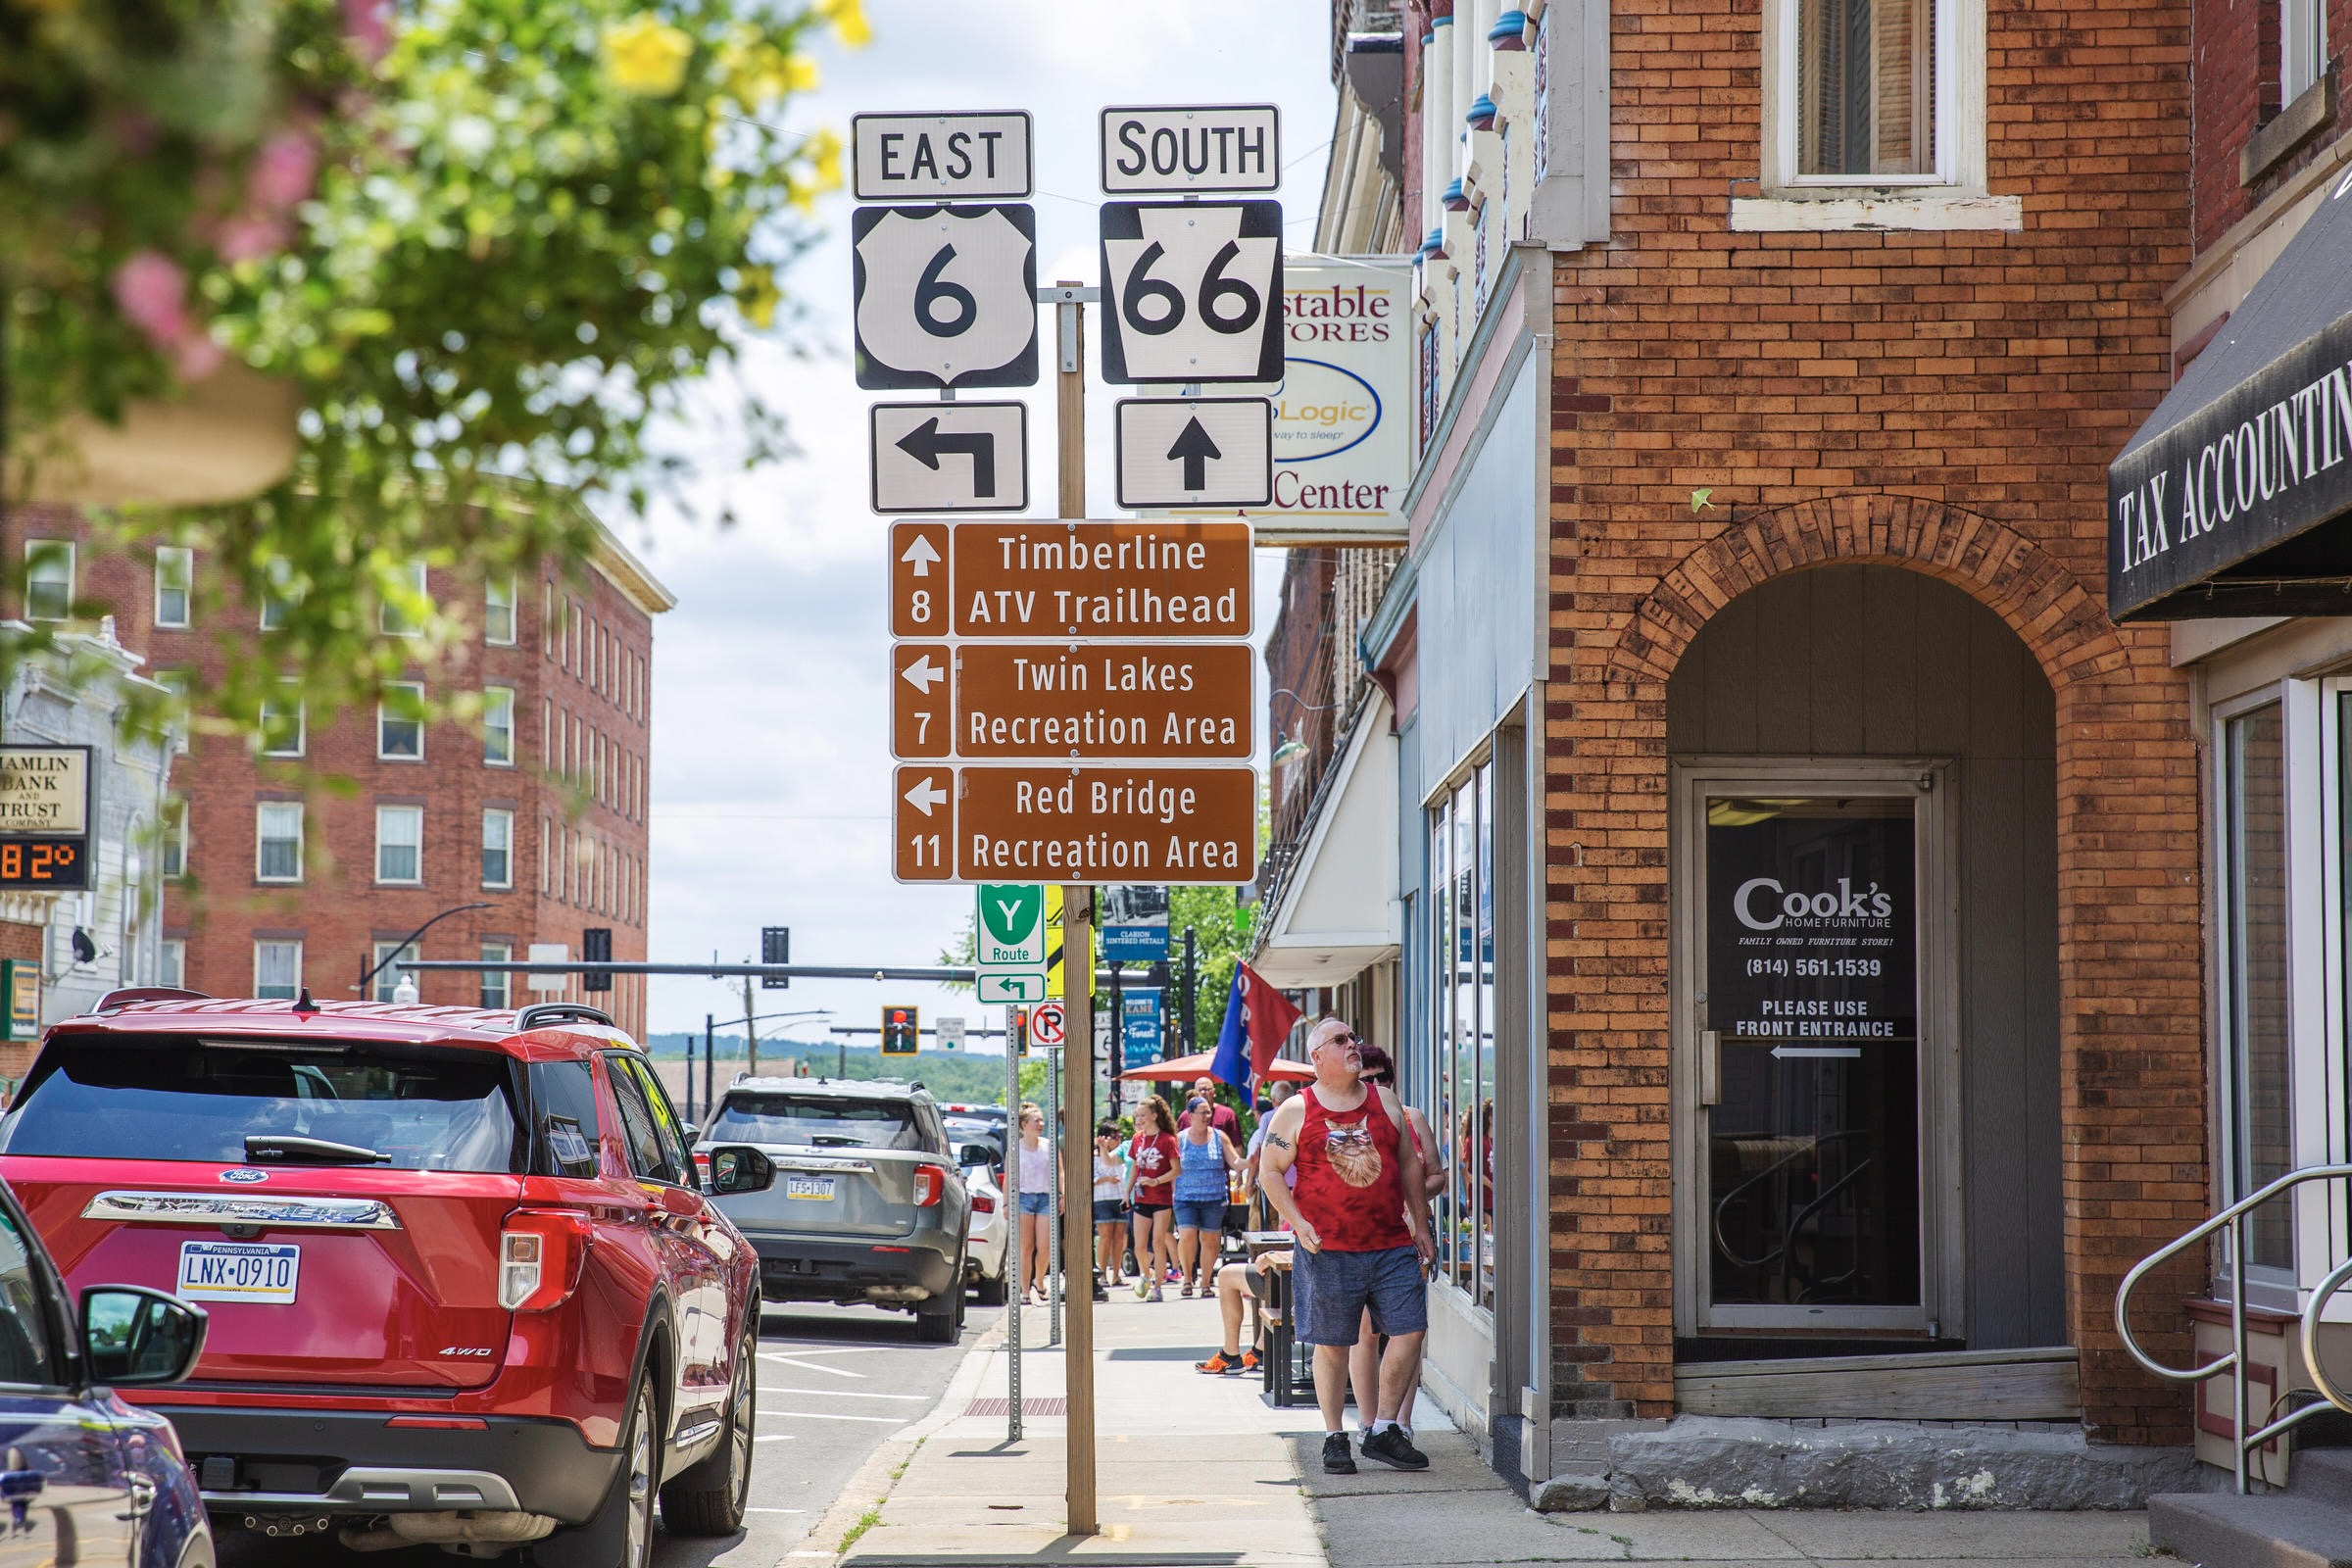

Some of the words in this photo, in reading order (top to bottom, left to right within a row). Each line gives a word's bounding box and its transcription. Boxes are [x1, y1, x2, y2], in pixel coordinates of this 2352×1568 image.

[880, 131, 1003, 180] EAST
[1116, 120, 1265, 176] SOUTH
[914, 242, 977, 337] 6
[1123, 240, 1261, 335] 66
[1283, 284, 1390, 318] stable
[1284, 322, 1390, 342] ORES
[1273, 401, 1367, 426] Logic
[1297, 431, 1307, 440] to
[1274, 470, 1390, 510] Center
[2118, 470, 2170, 573] TAX
[998, 534, 1206, 570] Timberline
[910, 590, 932, 623] 8
[968, 591, 1036, 623] ATV
[1054, 587, 1236, 623] Trailhead
[1013, 656, 1087, 692] Twin
[1104, 657, 1194, 692] Lakes
[913, 712, 932, 745] 7
[970, 709, 1147, 745] Recreation
[1162, 711, 1237, 745] Area
[1, 775, 57, 791] BANK
[0, 803, 62, 818] TRUST
[1016, 780, 1074, 814] Red
[1091, 779, 1197, 824] Bridge
[910, 834, 941, 867] 11
[973, 832, 1150, 867] Recreation
[1165, 835, 1239, 867] Area
[997, 900, 1022, 931] Y
[1733, 877, 1892, 931] Cook's
[1786, 917, 1821, 928] HOME
[1825, 917, 1891, 928] FURNITURE
[993, 947, 1029, 960] Route
[1739, 937, 1772, 946] FAMILY
[1746, 958, 1788, 977] (814)
[1795, 958, 1882, 976] 561.1539
[1125, 1004, 1153, 1013] KANE
[1762, 1001, 1829, 1016] PLEASE
[1834, 1001, 1868, 1016] USE
[1128, 1026, 1155, 1039] Forest
[1737, 1020, 1794, 1036] FRONT
[1799, 1021, 1894, 1037] ENTRANCE
[212, 1246, 270, 1255] PENNSYLVANIA
[438, 1347, 493, 1356] 4WD
